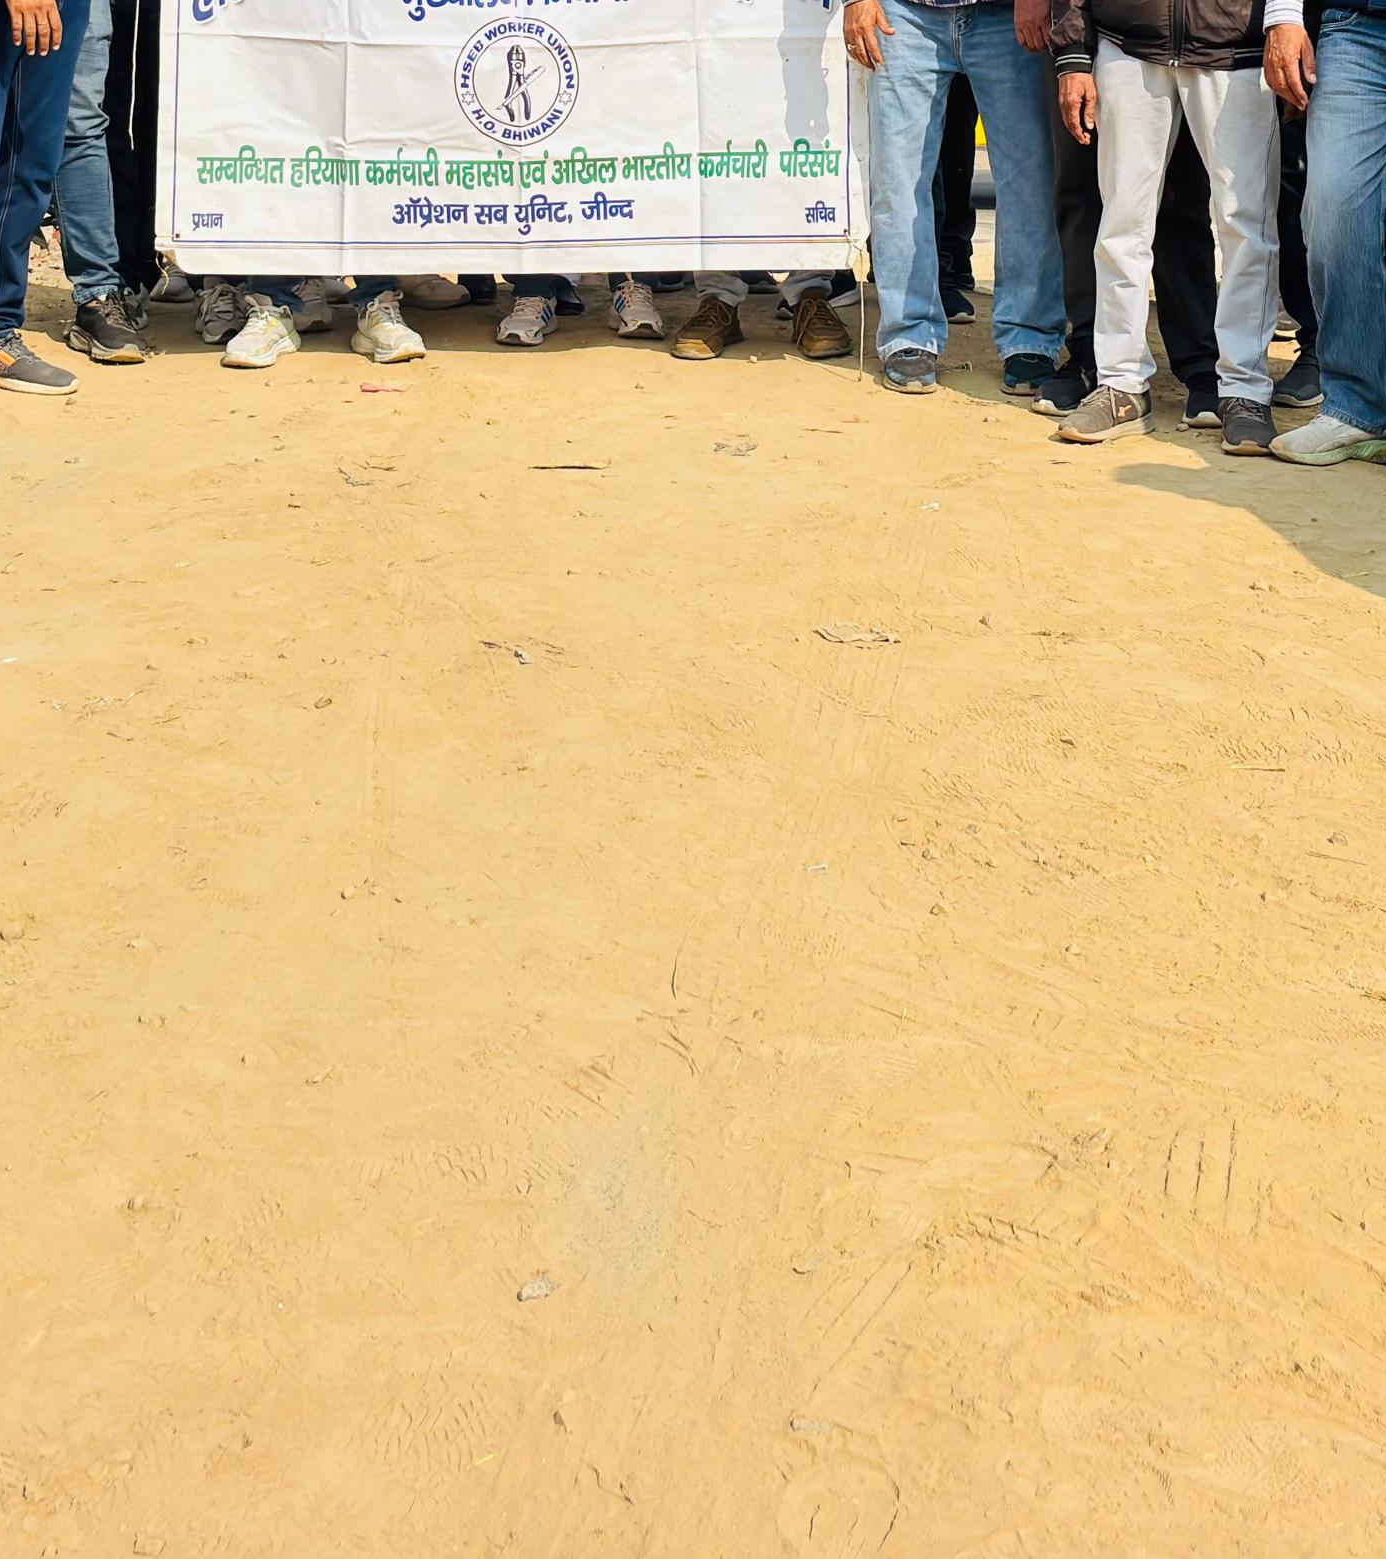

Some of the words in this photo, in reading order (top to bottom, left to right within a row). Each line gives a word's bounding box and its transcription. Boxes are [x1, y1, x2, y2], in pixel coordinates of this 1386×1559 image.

[460, 39, 484, 89] HSEB
[484, 22, 545, 42] WORKER
[547, 33, 575, 89] UNION
[472, 108, 496, 133] H.O.
[501, 108, 564, 141] BHIWANI
[197, 144, 285, 185] सम्बन्धित
[290, 145, 360, 188] हरियाणा
[365, 147, 439, 187] कर्मचारी
[445, 149, 514, 190] महासंघ
[519, 150, 549, 188] एवं
[551, 146, 618, 185] अखिल
[622, 141, 692, 181] भारतीय
[697, 139, 769, 179] कर्मचारी
[779, 138, 841, 178] परिसंघ
[192, 213, 223, 231] प्रधान
[392, 196, 469, 228] ऑप्रेशन
[474, 204, 508, 225] सब
[579, 191, 635, 220] जीन्द
[805, 200, 836, 223] सचिव
